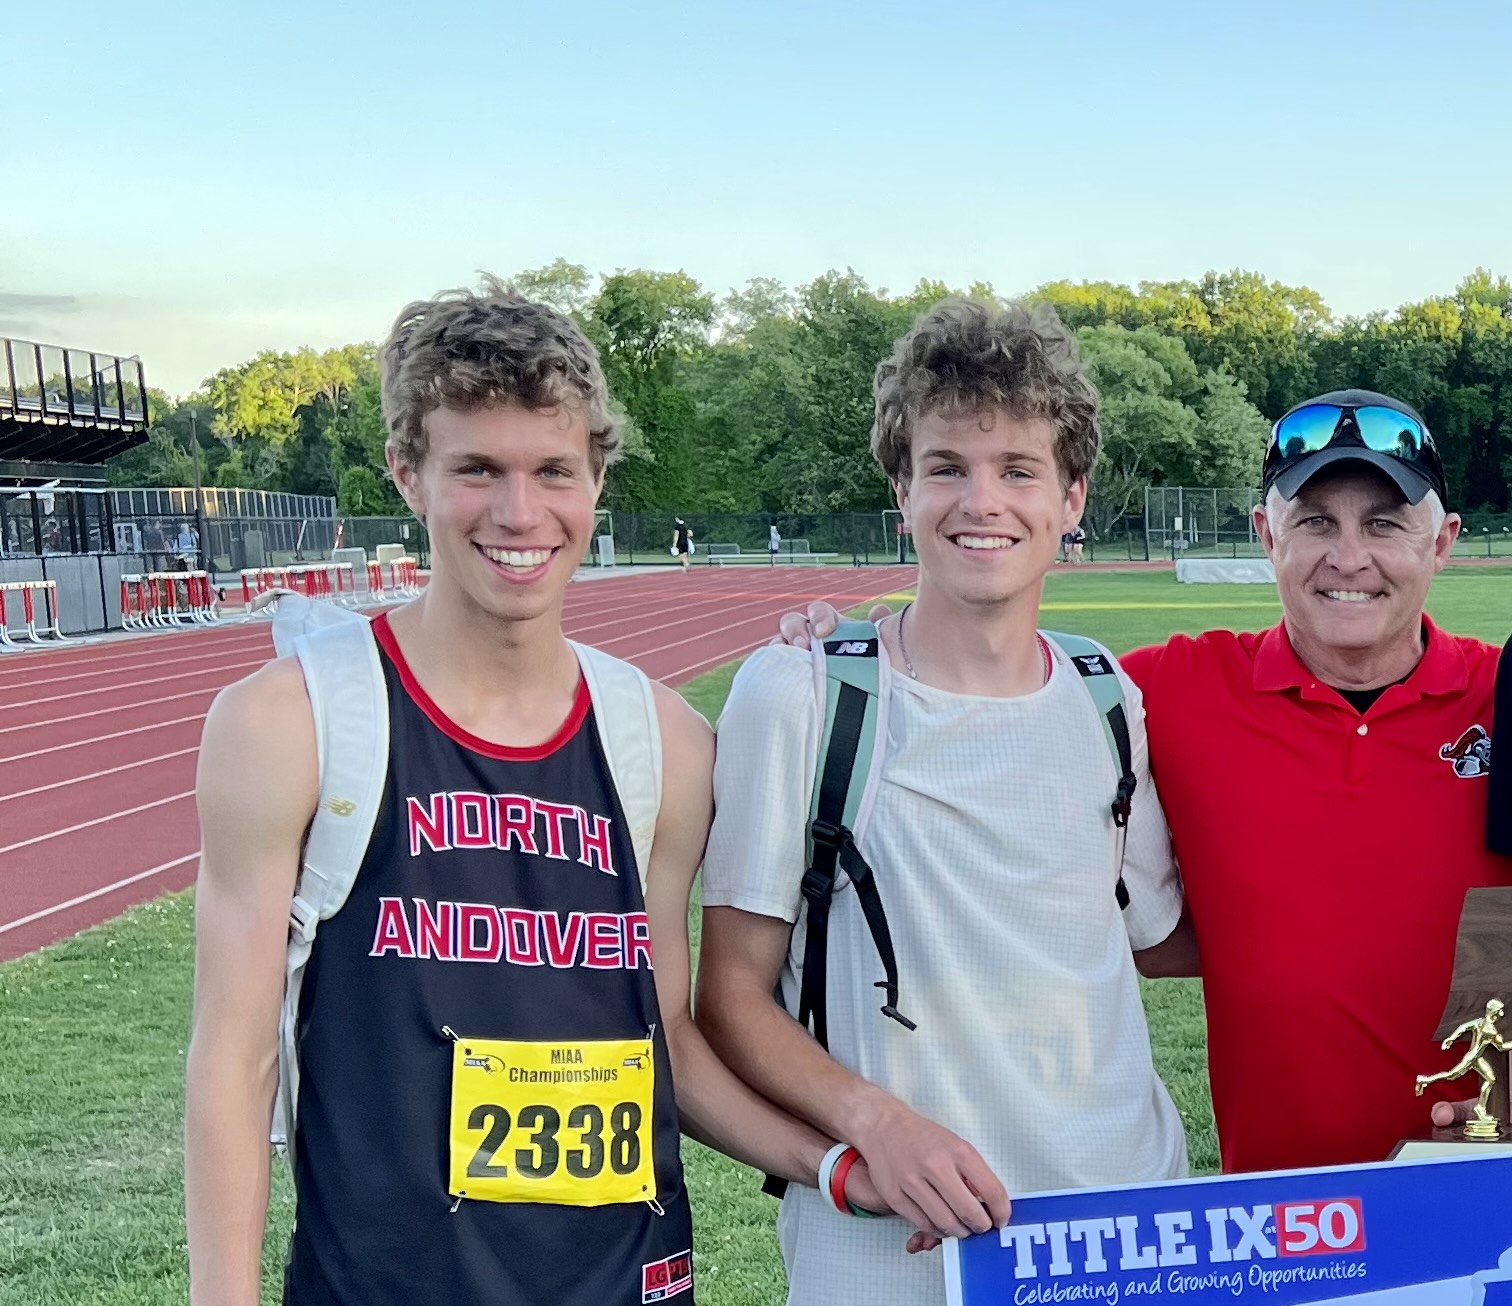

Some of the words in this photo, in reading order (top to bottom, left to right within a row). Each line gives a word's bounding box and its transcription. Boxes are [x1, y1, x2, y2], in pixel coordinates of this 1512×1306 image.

[406, 792, 619, 876] NORTH
[368, 897, 654, 970] ANDOVER
[509, 1067, 619, 1083] Championships
[551, 1049, 584, 1064] MIAA
[466, 1101, 642, 1179] 2338
[1000, 1210, 1198, 1280] TITLE
[1205, 1204, 1276, 1263] IX
[1284, 1202, 1359, 1252] 50
[1014, 1278, 1118, 1306] Celebrating
[1124, 1273, 1161, 1296] and
[1168, 1270, 1244, 1296] Growing
[1248, 1259, 1367, 1293] Opportunities
